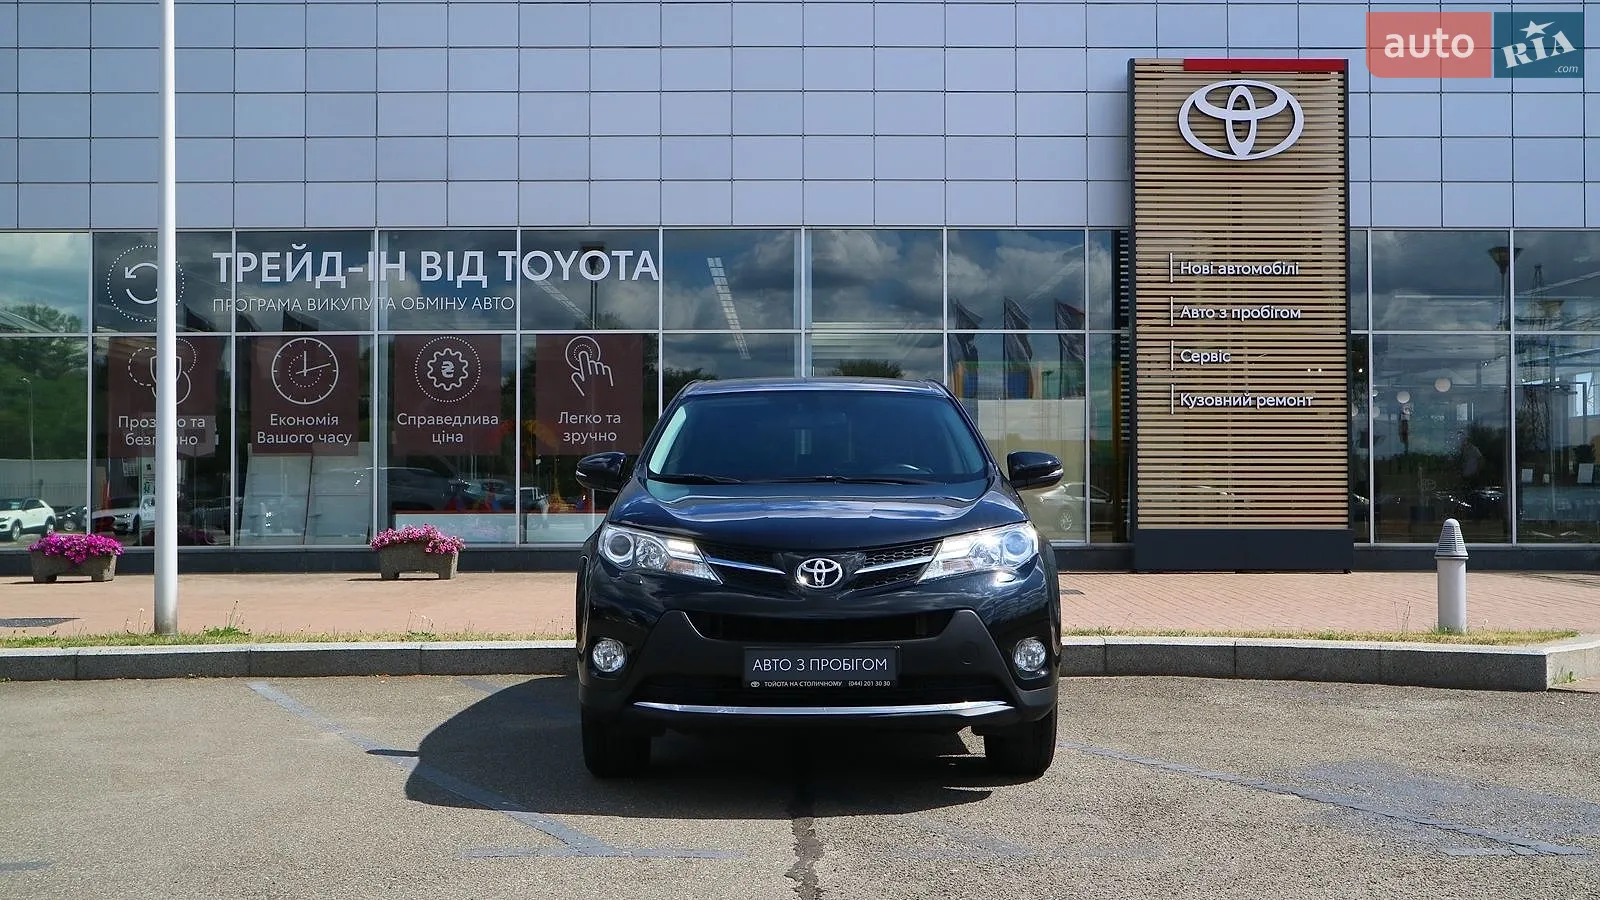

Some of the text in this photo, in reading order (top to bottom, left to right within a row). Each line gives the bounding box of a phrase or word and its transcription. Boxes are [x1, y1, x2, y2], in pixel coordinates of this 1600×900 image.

[212, 243, 660, 288] ТРЕЙД-ІН ВІД TOYOTA
[1180, 262, 1299, 275] Нові автомобілі
[213, 296, 515, 312] ПРОГРАМА ВИКУПУ ТА ОБМІНУ АВТО
[1180, 305, 1301, 322] Авто з пробігом
[1180, 349, 1231, 365] Сервіс
[1180, 392, 1314, 410] Кузовний ремонт
[118, 415, 206, 431] Прозо та
[270, 413, 339, 426] Економія
[397, 413, 499, 428] Справедлива
[558, 411, 621, 424] Легко та
[257, 431, 352, 446] Вашого часу
[432, 430, 464, 444] ціна
[563, 431, 617, 445] зручно
[752, 658, 887, 671] АВТО З ПРОБІГОМ
[764, 680, 788, 688] ТОЙОТА
